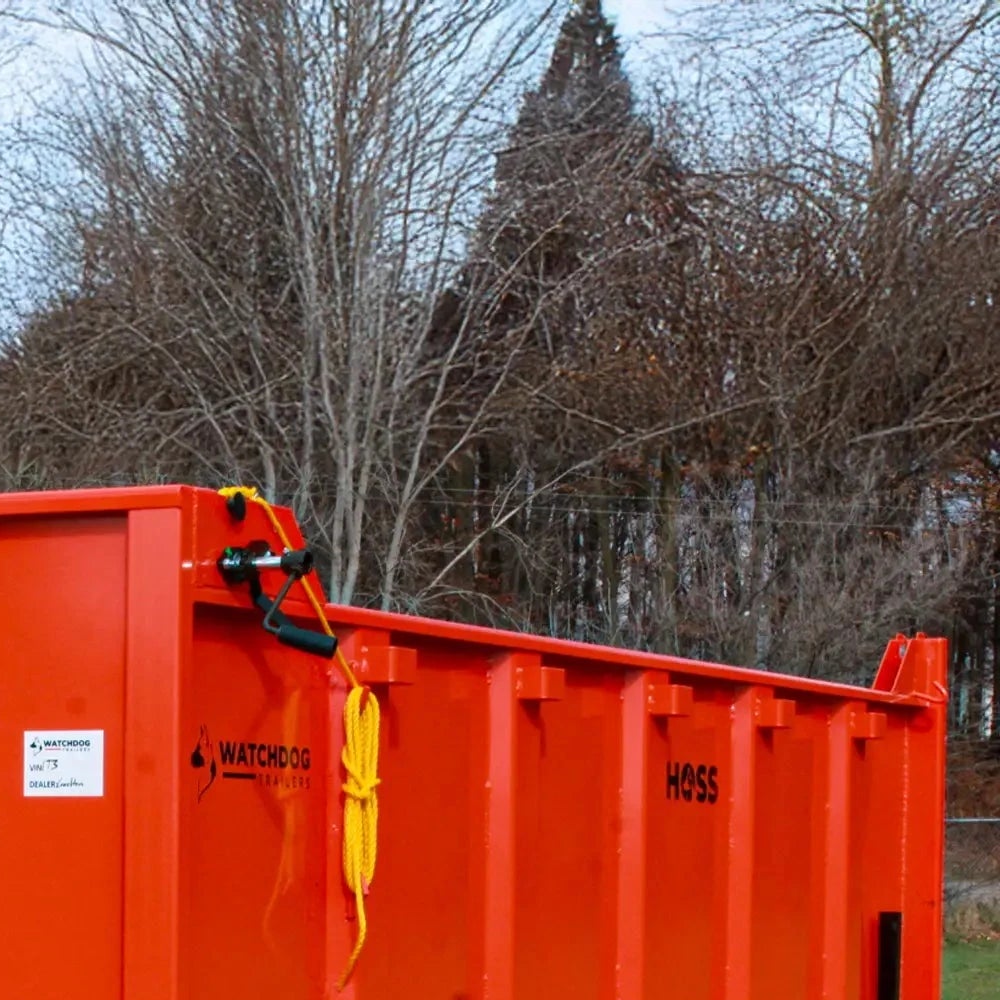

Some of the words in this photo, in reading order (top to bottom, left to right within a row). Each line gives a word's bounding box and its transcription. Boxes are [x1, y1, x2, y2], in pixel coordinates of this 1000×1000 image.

[43, 739, 91, 747] WATCHDOG
[219, 740, 311, 770] WATCHDOG
[258, 774, 311, 790] TRAILERS
[666, 760, 719, 805] HOSS
